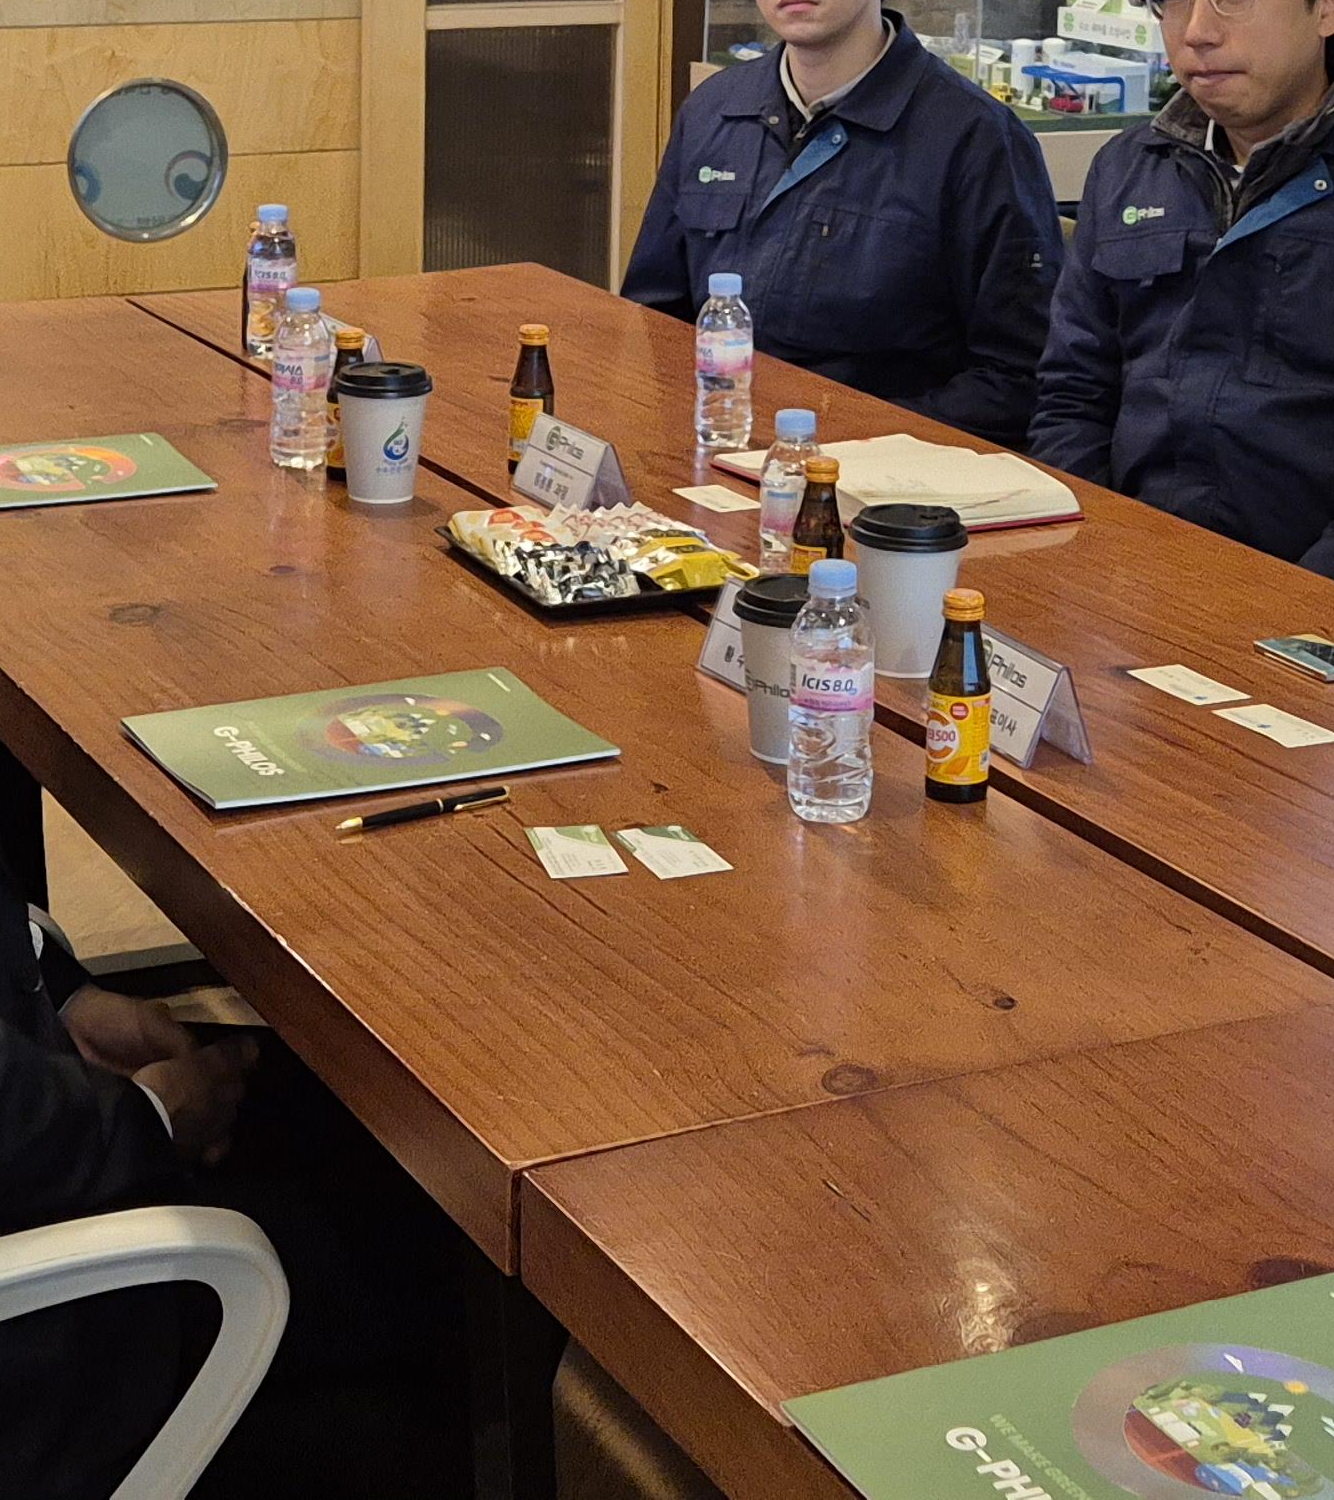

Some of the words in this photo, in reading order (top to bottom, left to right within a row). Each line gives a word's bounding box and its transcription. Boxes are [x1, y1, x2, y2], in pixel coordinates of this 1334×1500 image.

[802, 674, 830, 691] ICIS
[833, 679, 854, 692] 8.0
[989, 653, 1028, 689] Philos
[754, 679, 791, 698] Philo
[991, 708, 1017, 737] 표이사
[213, 725, 285, 777] G-PHILOS
